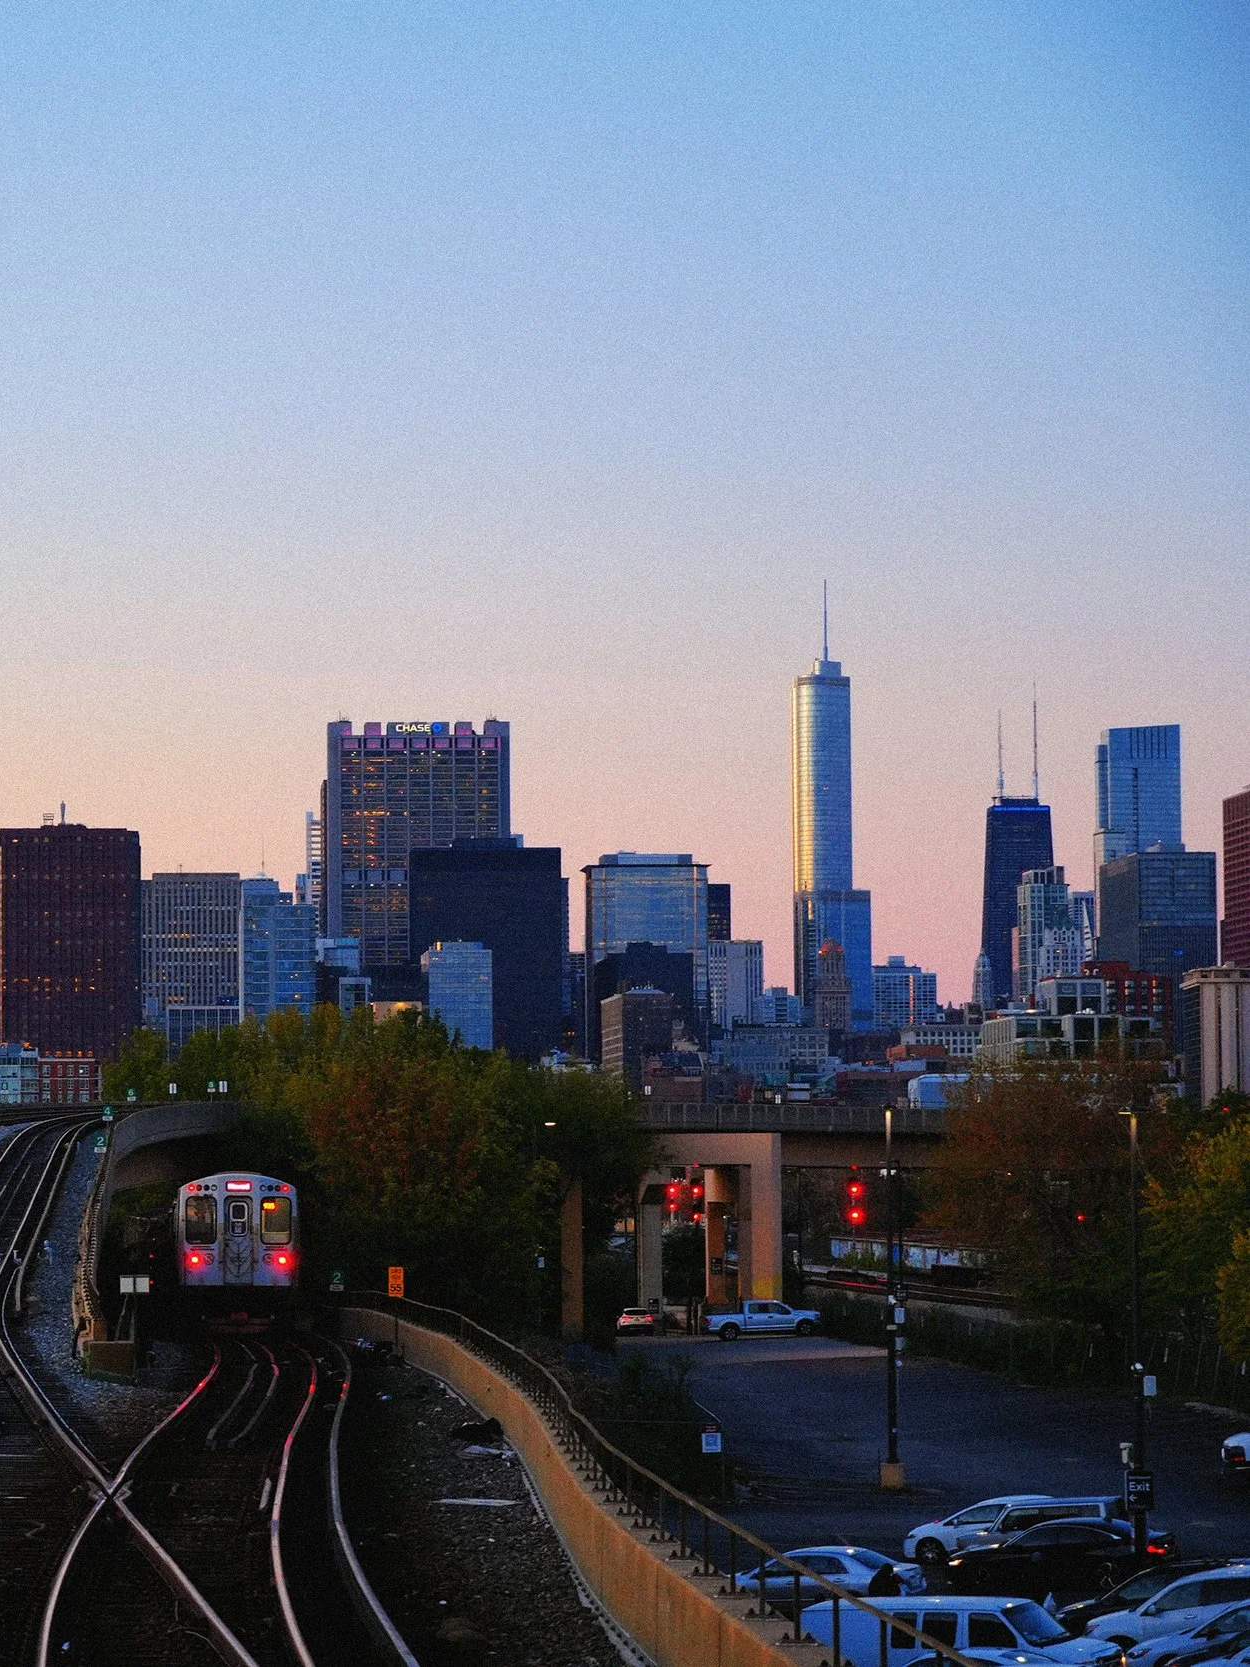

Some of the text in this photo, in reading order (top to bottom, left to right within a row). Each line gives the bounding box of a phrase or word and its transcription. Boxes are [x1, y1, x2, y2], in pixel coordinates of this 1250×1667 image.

[396, 724, 431, 732] CHASE
[97, 1136, 104, 1146] 2
[333, 1272, 341, 1283] 2
[390, 1284, 402, 1292] 55
[1129, 1481, 1150, 1491] Exit
